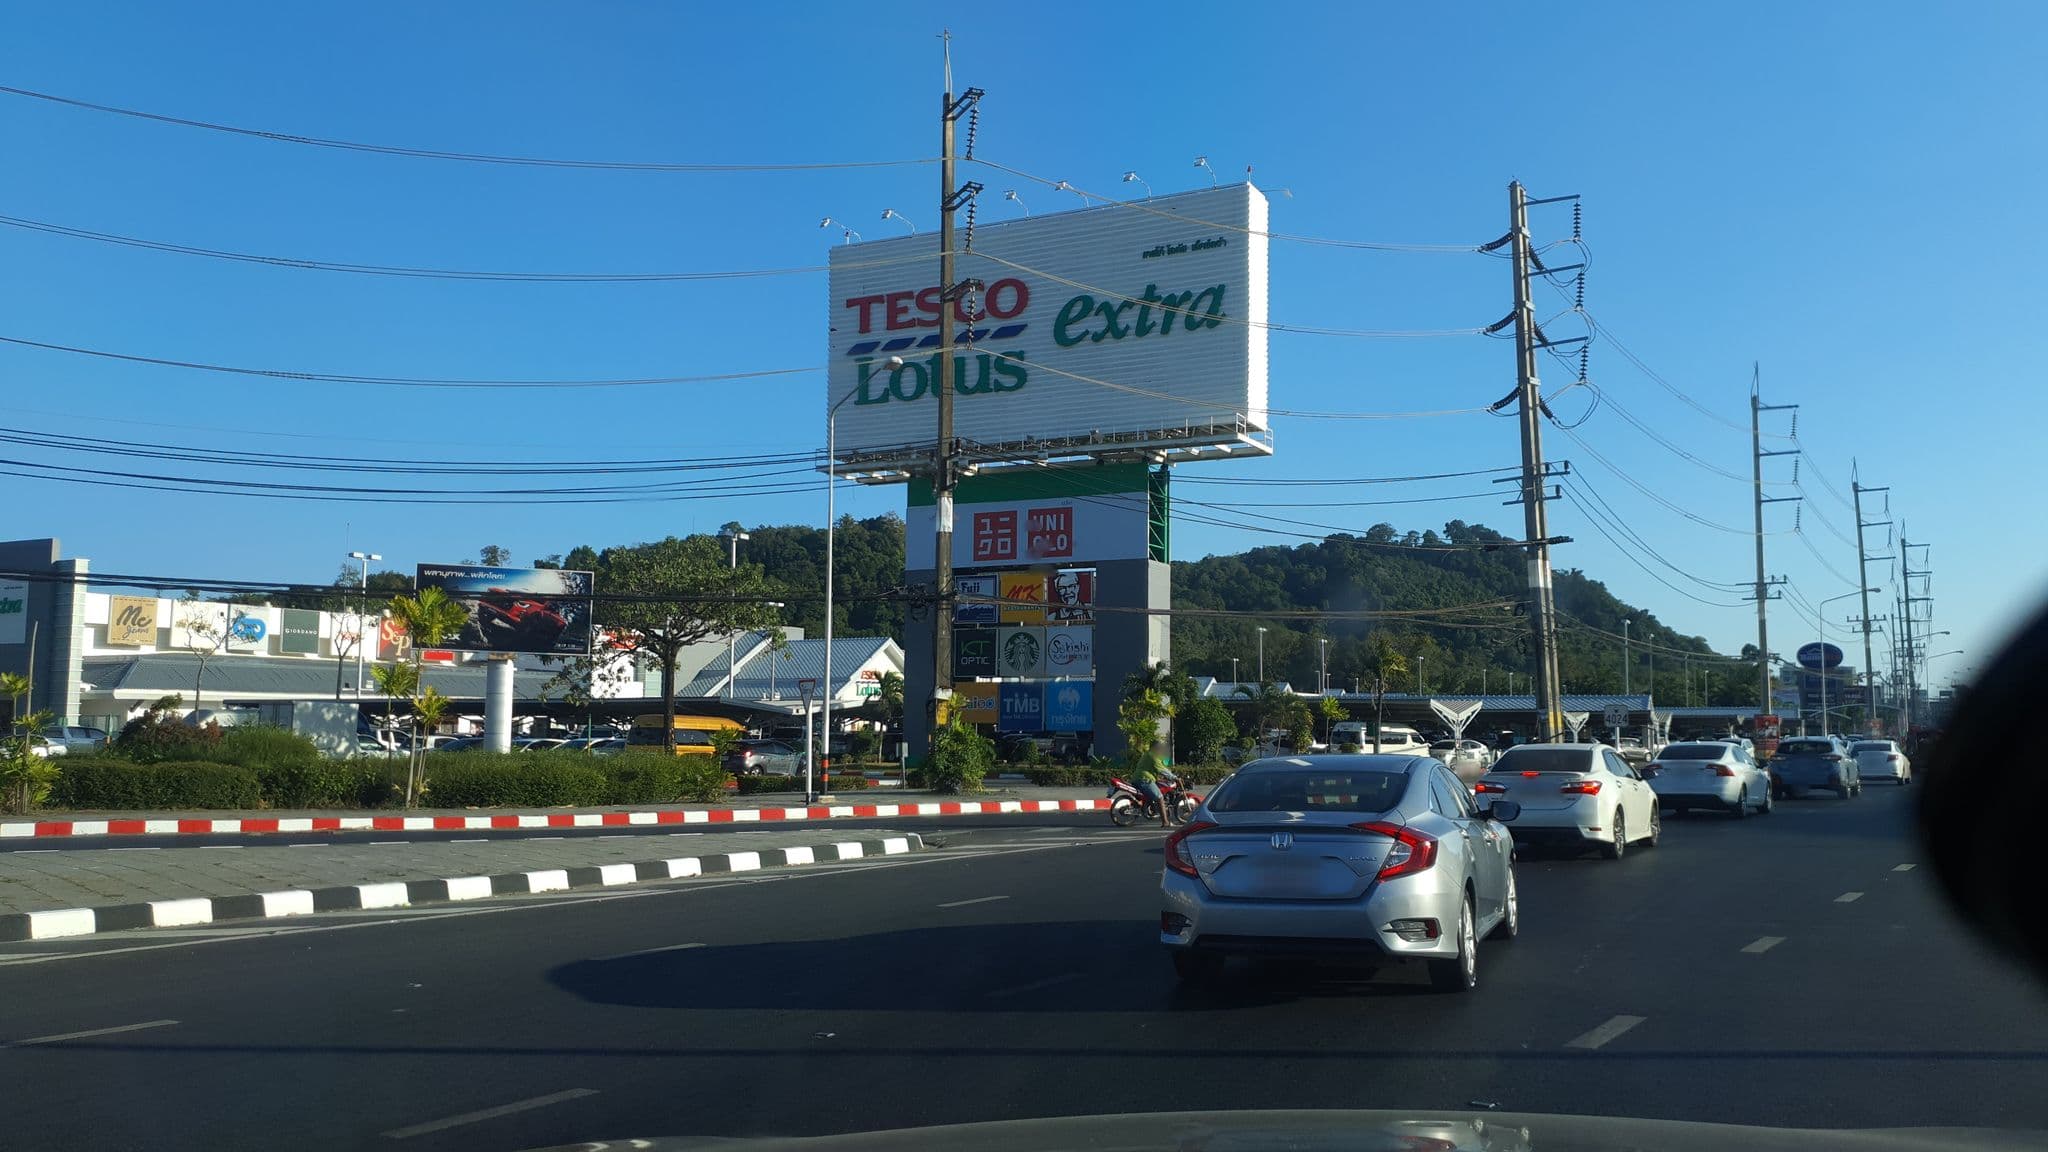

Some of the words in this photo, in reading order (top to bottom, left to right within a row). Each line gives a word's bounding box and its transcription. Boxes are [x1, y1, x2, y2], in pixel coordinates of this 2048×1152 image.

[846, 278, 1030, 334] TESCO
[1053, 283, 1226, 348] extra
[853, 350, 1029, 406] Lotus
[960, 582, 980, 594] Fuji
[1006, 583, 1042, 602] MK
[285, 627, 318, 635] GIORDANO
[960, 656, 990, 666] OPTIC
[1003, 698, 1040, 713] TMB
[1605, 713, 1628, 724] 4024
